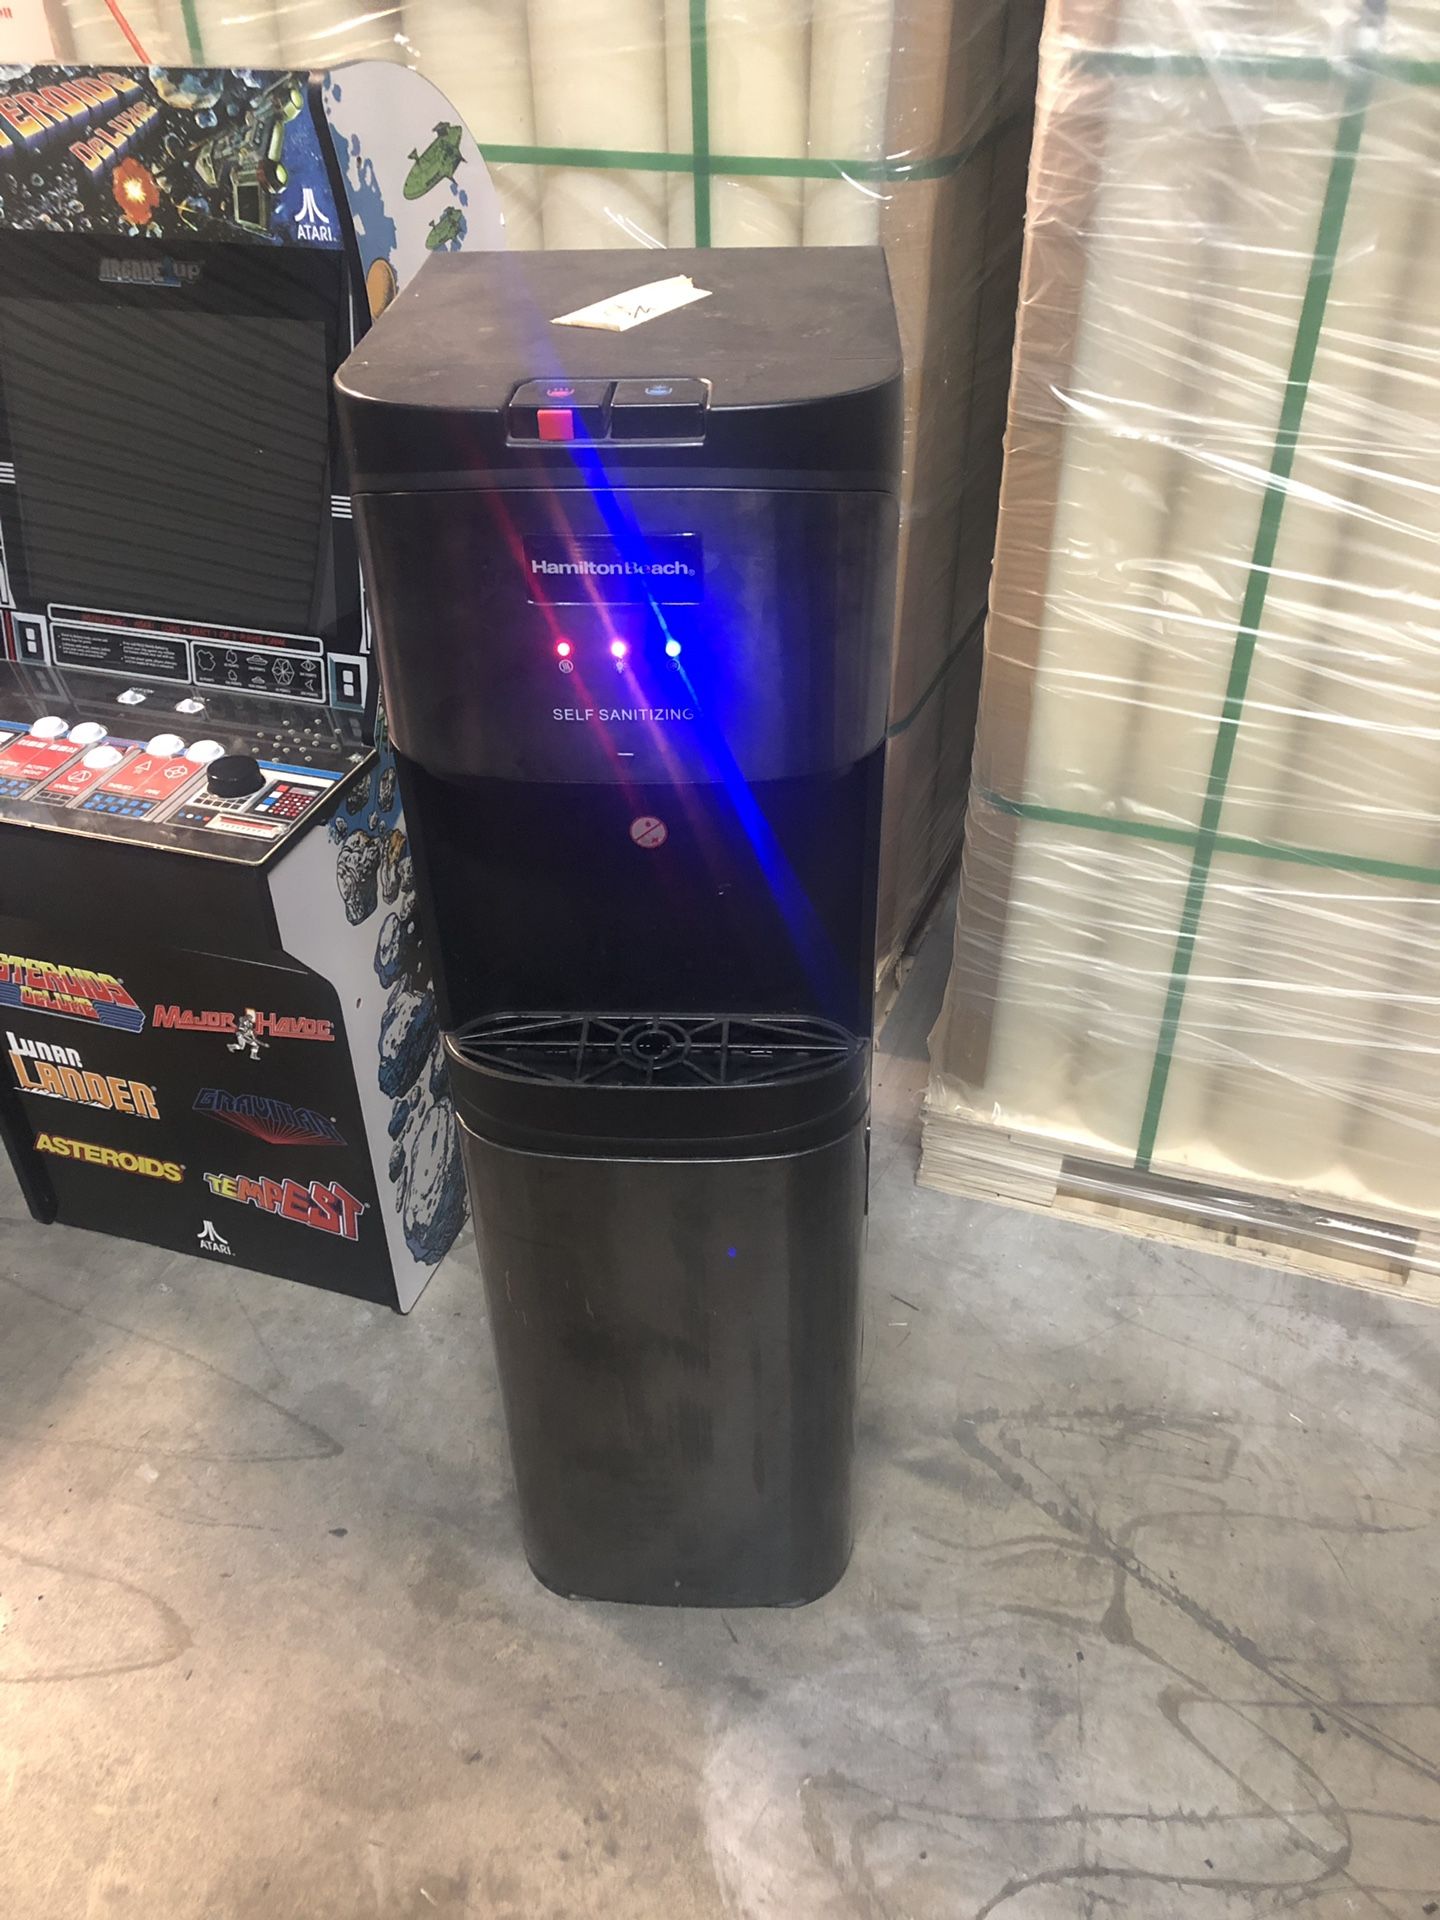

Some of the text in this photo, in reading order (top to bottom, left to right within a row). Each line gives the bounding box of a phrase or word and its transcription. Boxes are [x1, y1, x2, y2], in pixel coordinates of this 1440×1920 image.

[0, 72, 140, 147] EROIDS
[297, 223, 334, 241] ATARI
[531, 560, 623, 575] Hamilton
[552, 708, 694, 721] SELF SANITIZING
[9, 1051, 160, 1120] LANDER
[192, 1087, 348, 1145] GRAVITAR
[35, 1133, 184, 1182] ASTEROIDS
[203, 1172, 365, 1241] TEMPEST
[199, 1238, 232, 1255] ATARI
